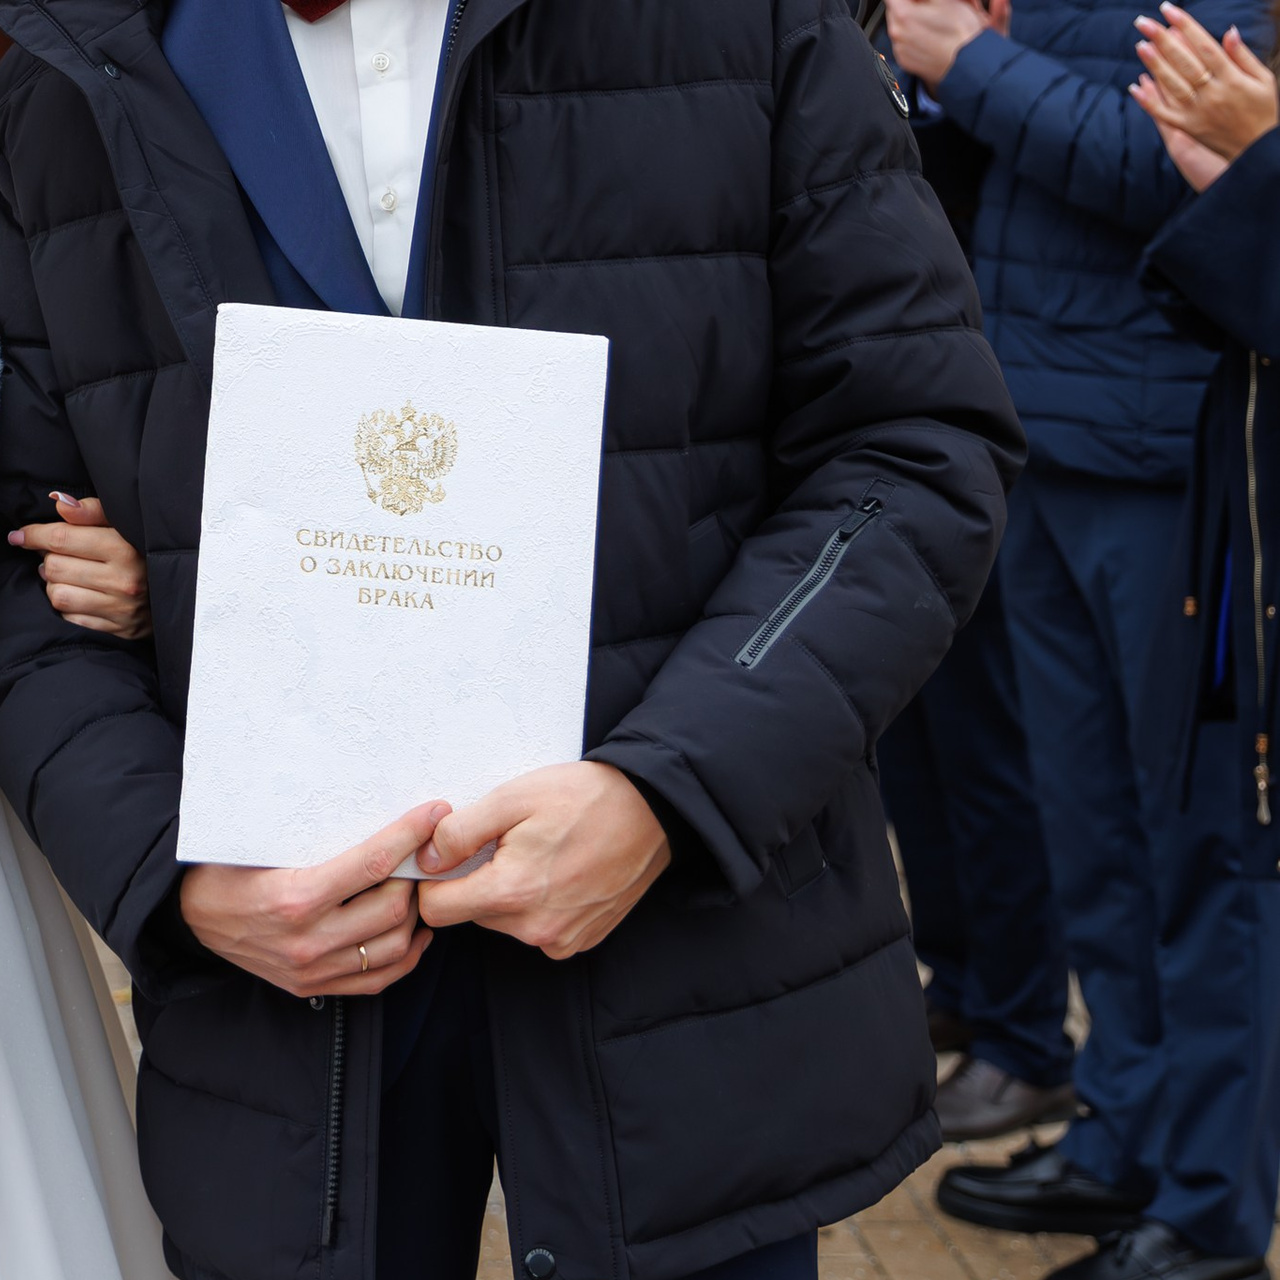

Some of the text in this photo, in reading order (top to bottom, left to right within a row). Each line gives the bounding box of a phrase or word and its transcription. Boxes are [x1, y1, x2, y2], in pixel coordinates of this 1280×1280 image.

[296, 528, 502, 562] СВИДЕТЕЛЬСТВО
[300, 556, 495, 588] О ЗАКЛЮЧЕНИИ
[358, 587, 435, 610] БРАКА
